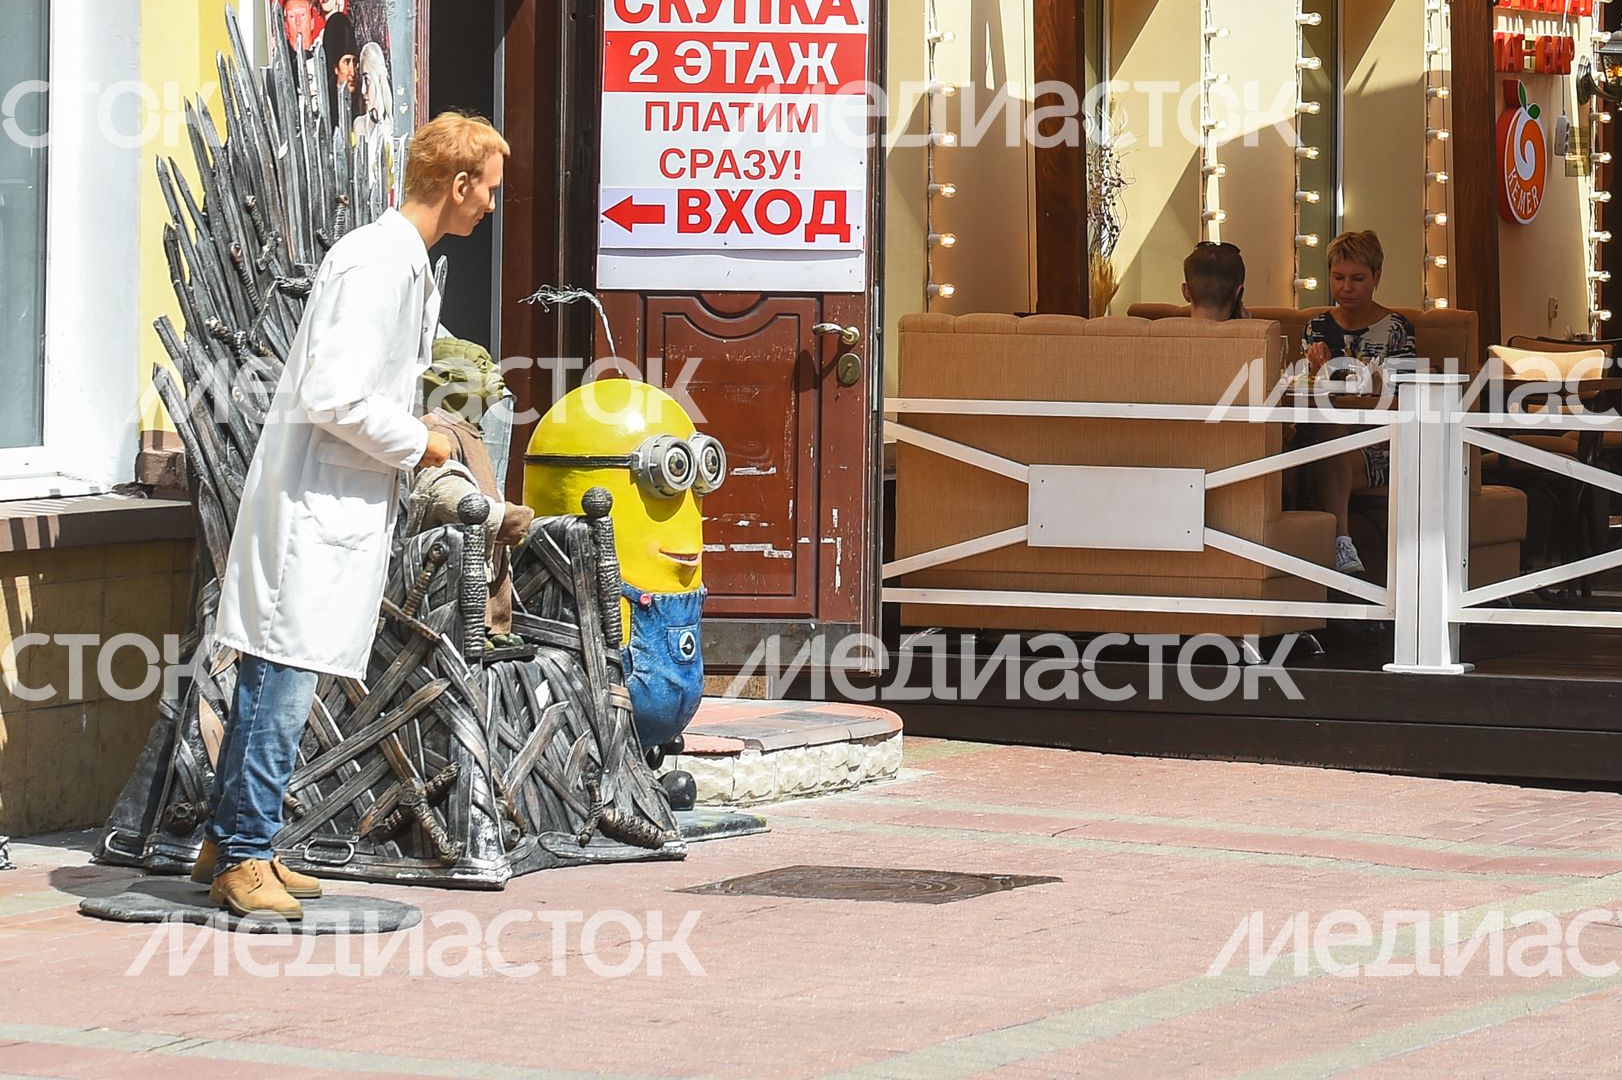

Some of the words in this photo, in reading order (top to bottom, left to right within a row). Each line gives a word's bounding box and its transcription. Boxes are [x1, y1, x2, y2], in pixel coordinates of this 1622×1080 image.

[628, 40, 659, 83] 2
[673, 40, 839, 85] ЭТАЖ
[644, 101, 819, 133] ПЛАТИМ
[658, 147, 801, 180] СРАЗУ!
[1508, 169, 1539, 215] KEMER
[676, 188, 852, 243] ВХОД
